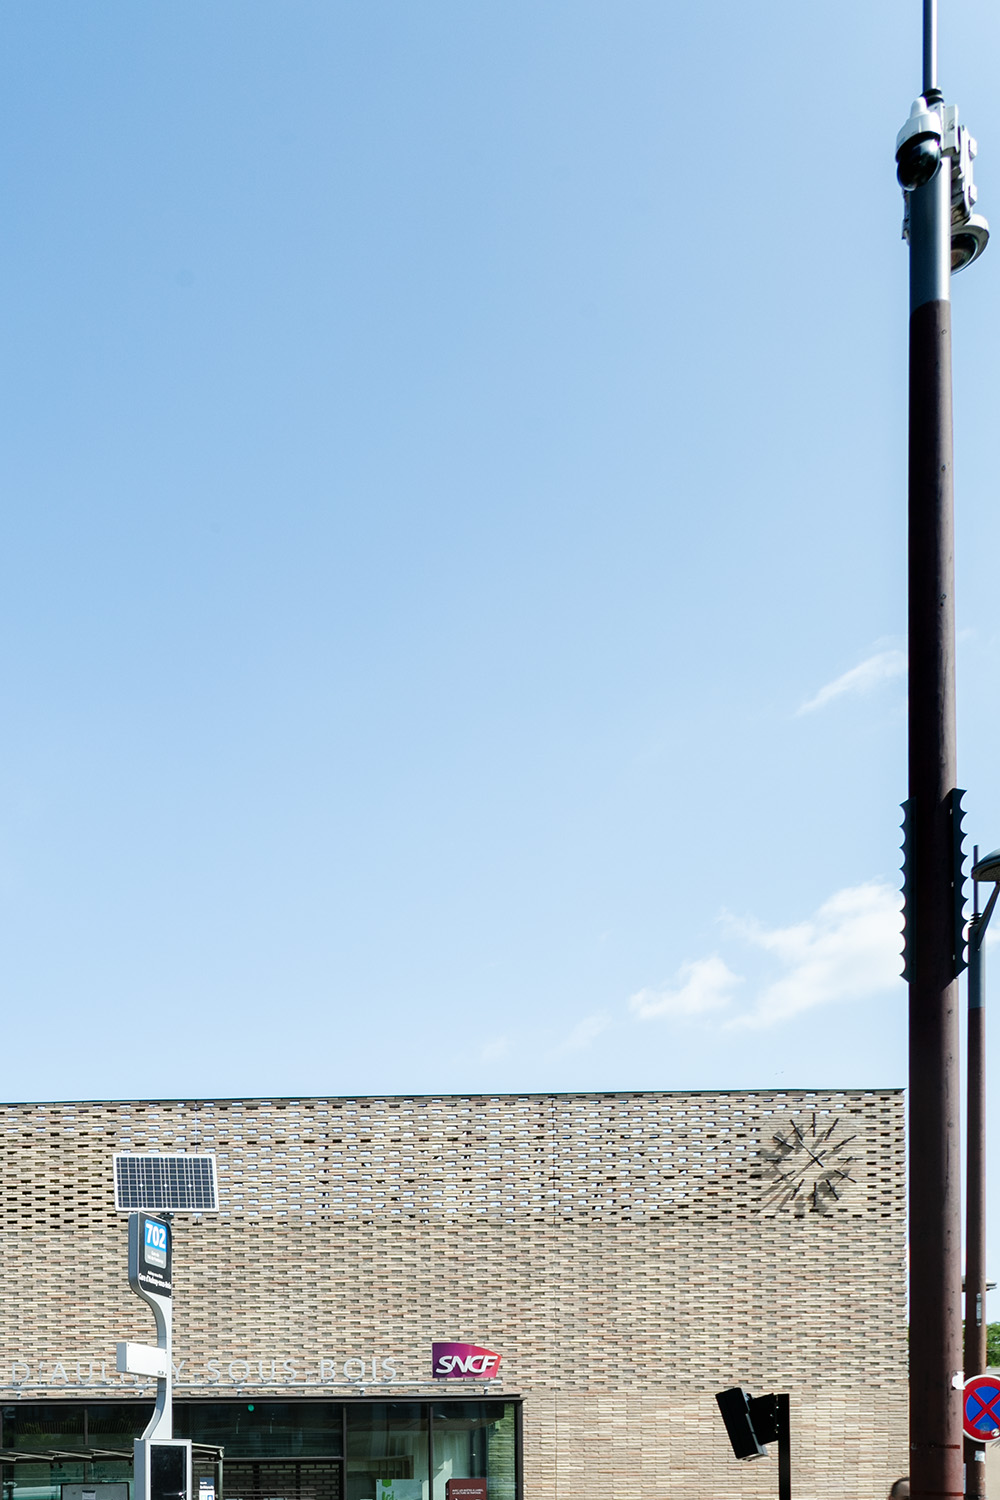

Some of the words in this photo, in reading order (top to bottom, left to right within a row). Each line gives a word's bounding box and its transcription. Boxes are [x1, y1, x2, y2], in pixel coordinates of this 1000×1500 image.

[145, 1223, 166, 1249] 702
[12, 1357, 397, 1384] D'AULY-SOUS-BOIS
[436, 1355, 498, 1374] SNCF
